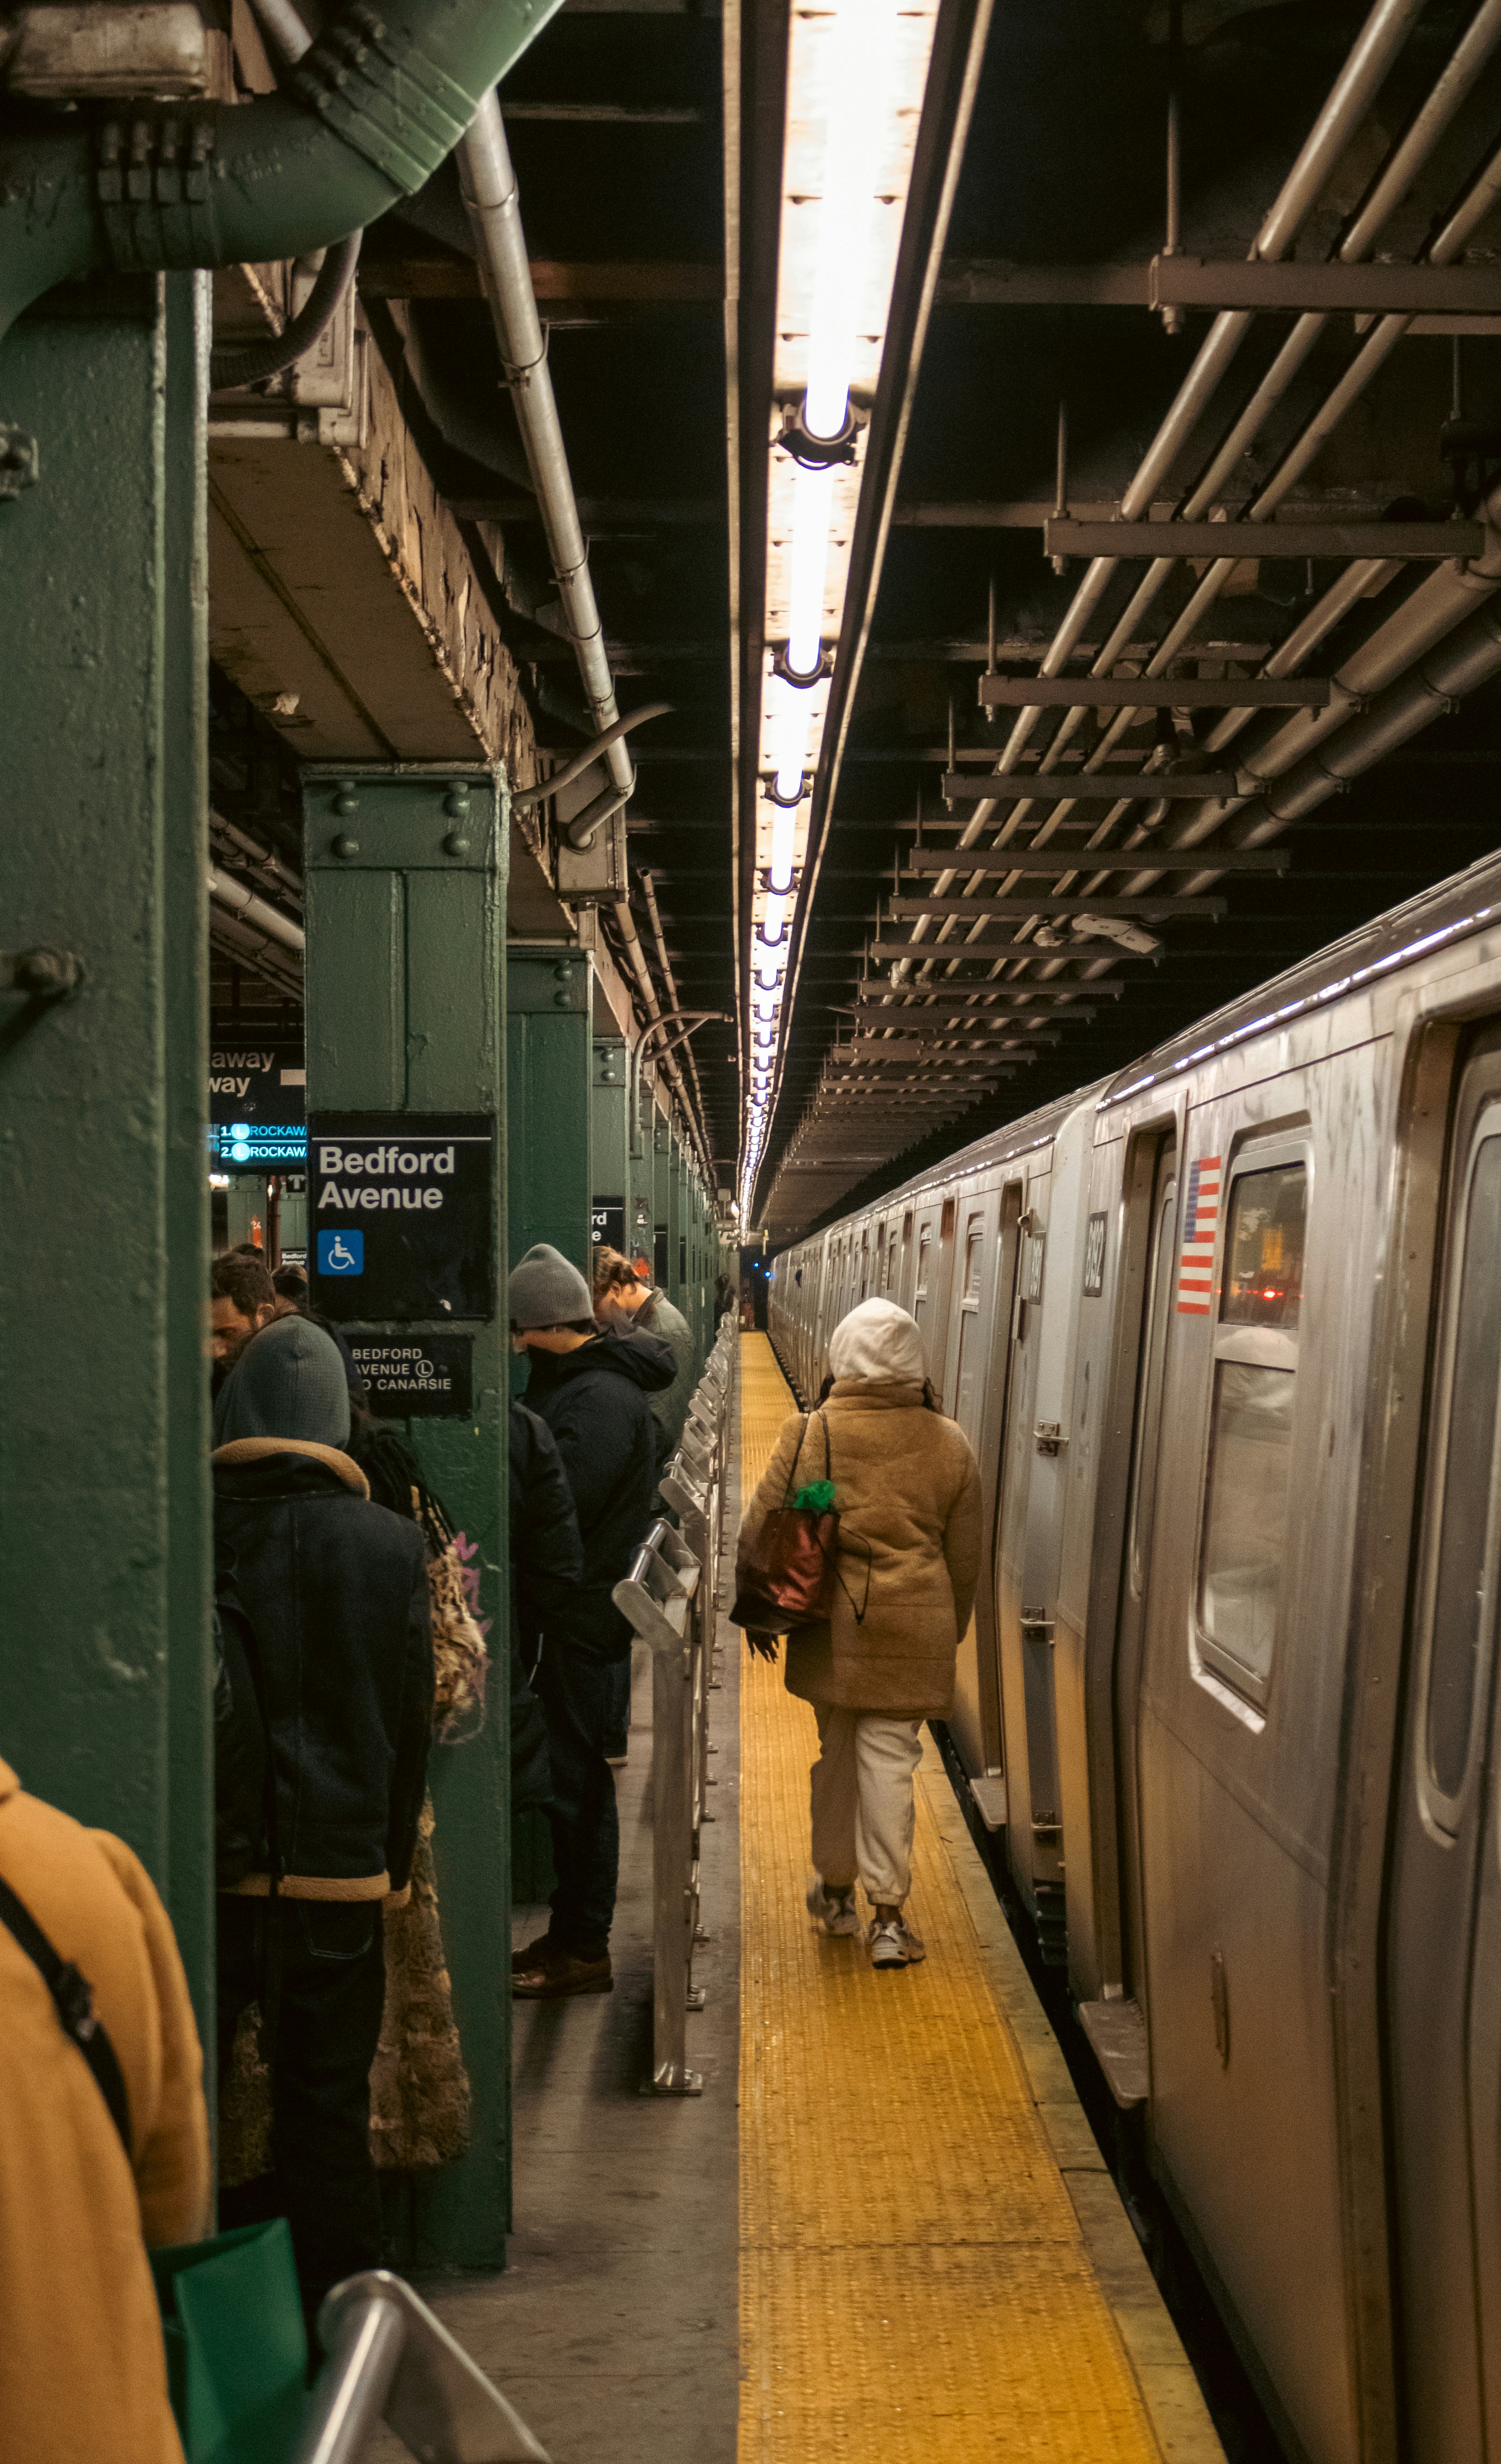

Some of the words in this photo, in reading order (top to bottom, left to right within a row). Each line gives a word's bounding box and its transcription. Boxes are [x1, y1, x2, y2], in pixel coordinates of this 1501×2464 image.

[250, 1146, 306, 1157] ROCKAW
[320, 1146, 454, 1173] Bedford
[317, 1181, 443, 1209] Avenue
[352, 1349, 422, 1359] BEDFORD
[377, 1379, 451, 1390] CANARSIE
